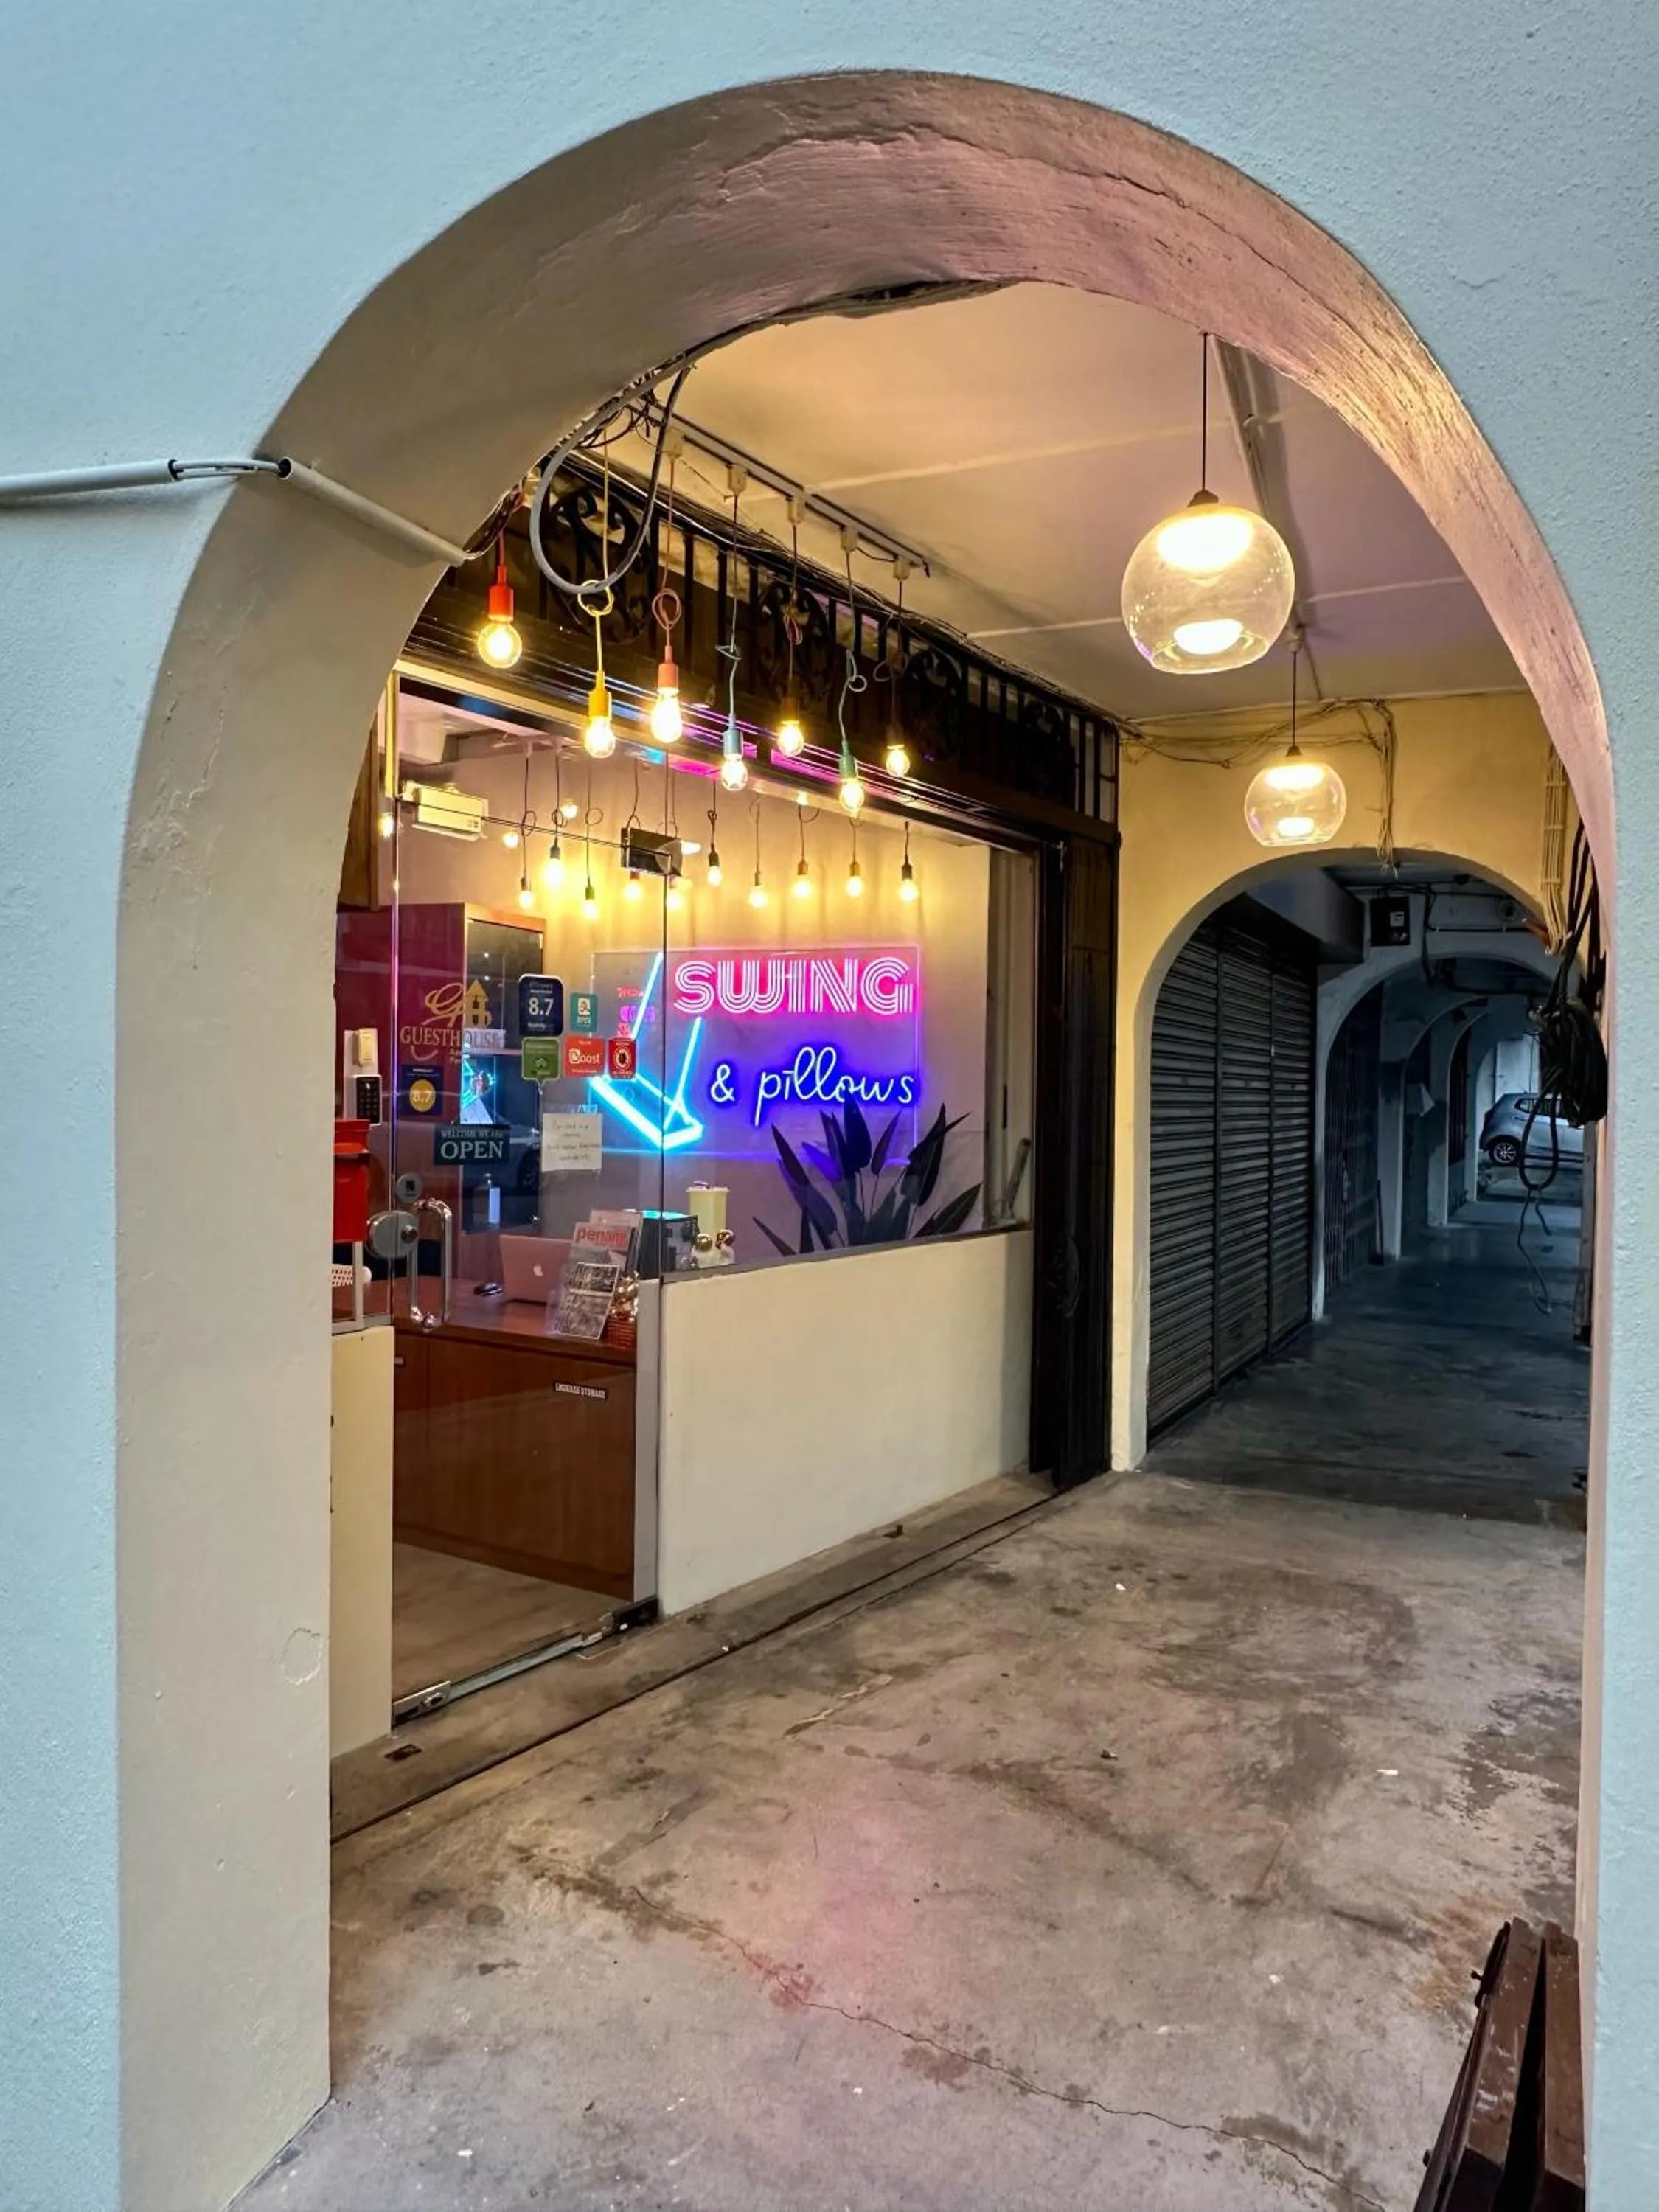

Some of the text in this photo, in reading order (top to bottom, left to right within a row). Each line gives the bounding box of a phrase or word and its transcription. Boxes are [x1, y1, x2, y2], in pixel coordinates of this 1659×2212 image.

[673, 956, 914, 1015] SWING
[529, 997, 554, 1015] 8.7
[710, 1046, 915, 1127] & pillows
[440, 1141, 504, 1160] OPEN
